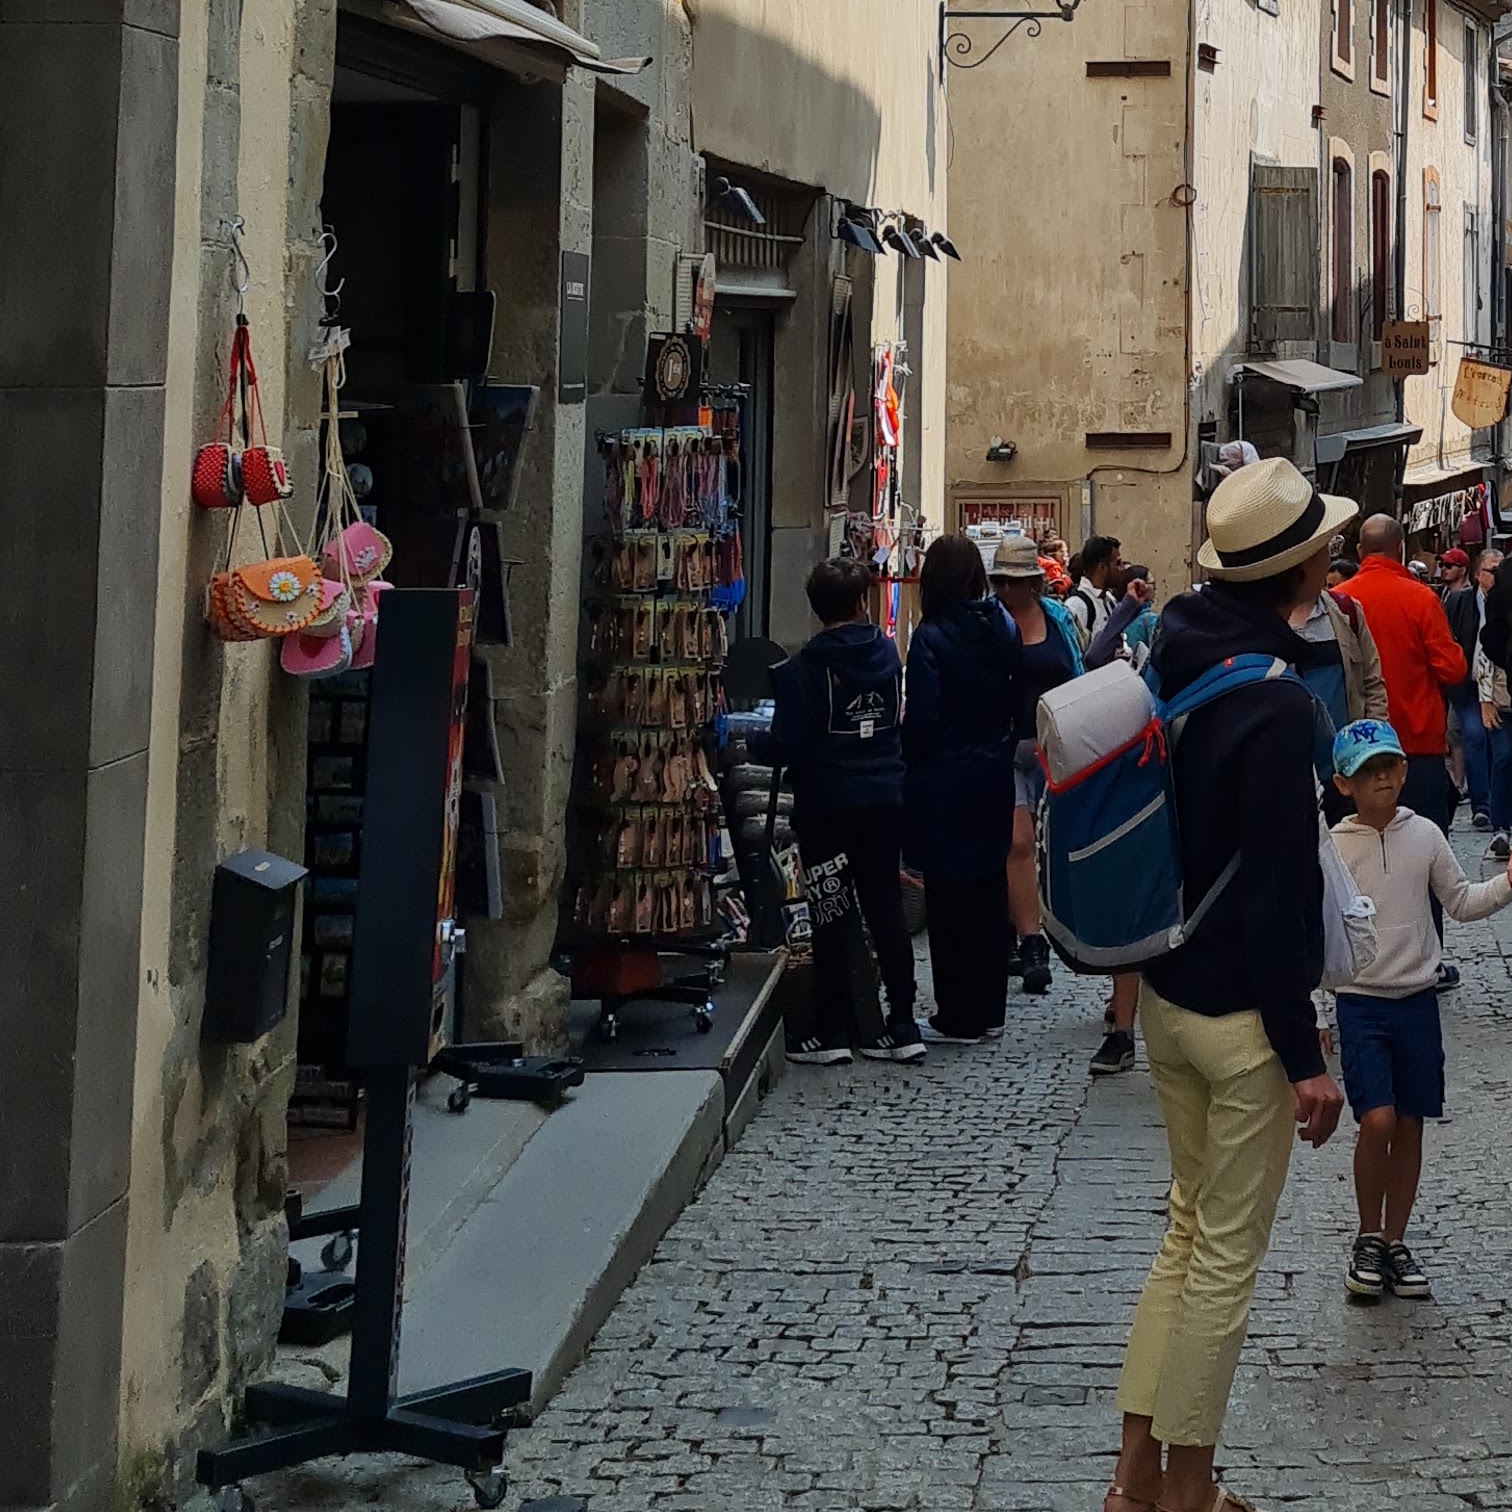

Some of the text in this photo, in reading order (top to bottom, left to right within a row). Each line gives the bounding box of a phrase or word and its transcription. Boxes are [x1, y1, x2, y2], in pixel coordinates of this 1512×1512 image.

[1394, 335, 1427, 349] Saint
[1388, 354, 1422, 369] Louis
[1349, 721, 1380, 745] NY
